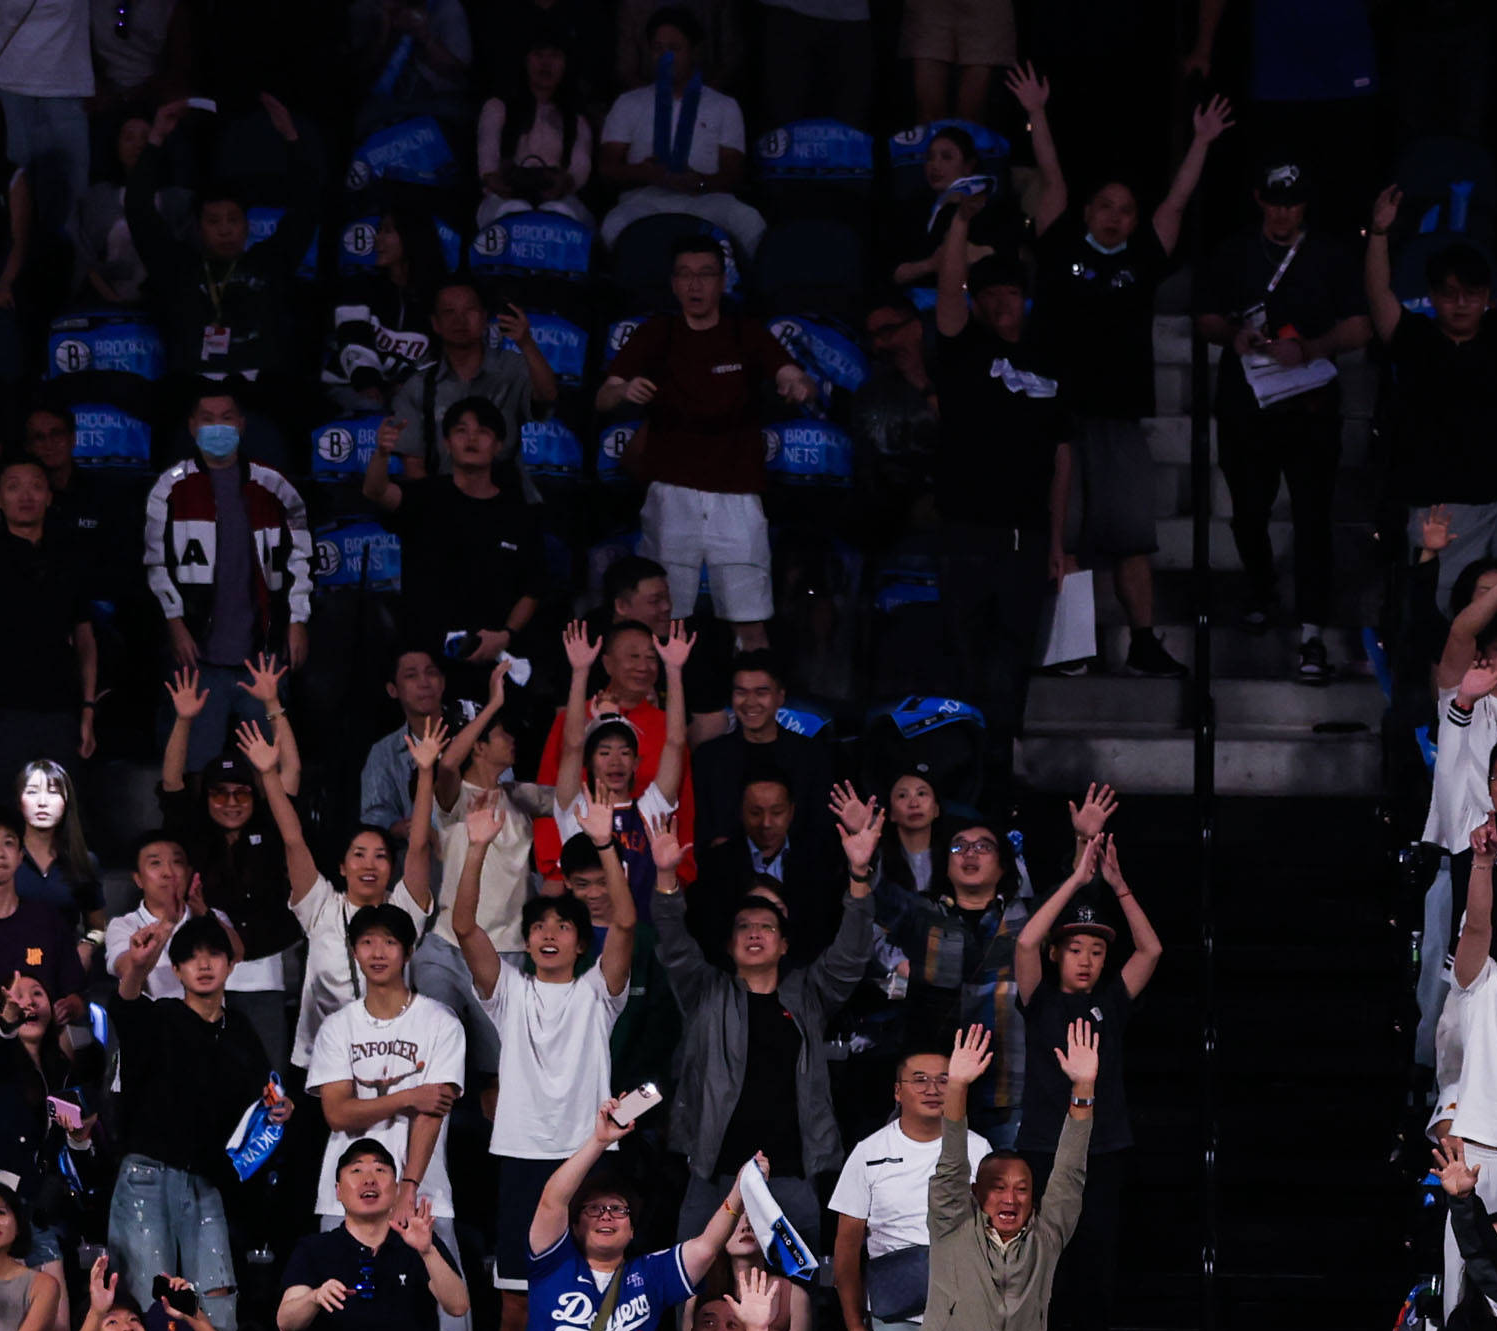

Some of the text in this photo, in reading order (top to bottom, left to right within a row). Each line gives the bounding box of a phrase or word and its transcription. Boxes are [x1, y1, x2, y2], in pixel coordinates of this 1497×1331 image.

[511, 223, 584, 246] BROOKLYN
[510, 241, 546, 261] NETS
[783, 445, 821, 465] NETS
[344, 533, 400, 555] BROOKL
